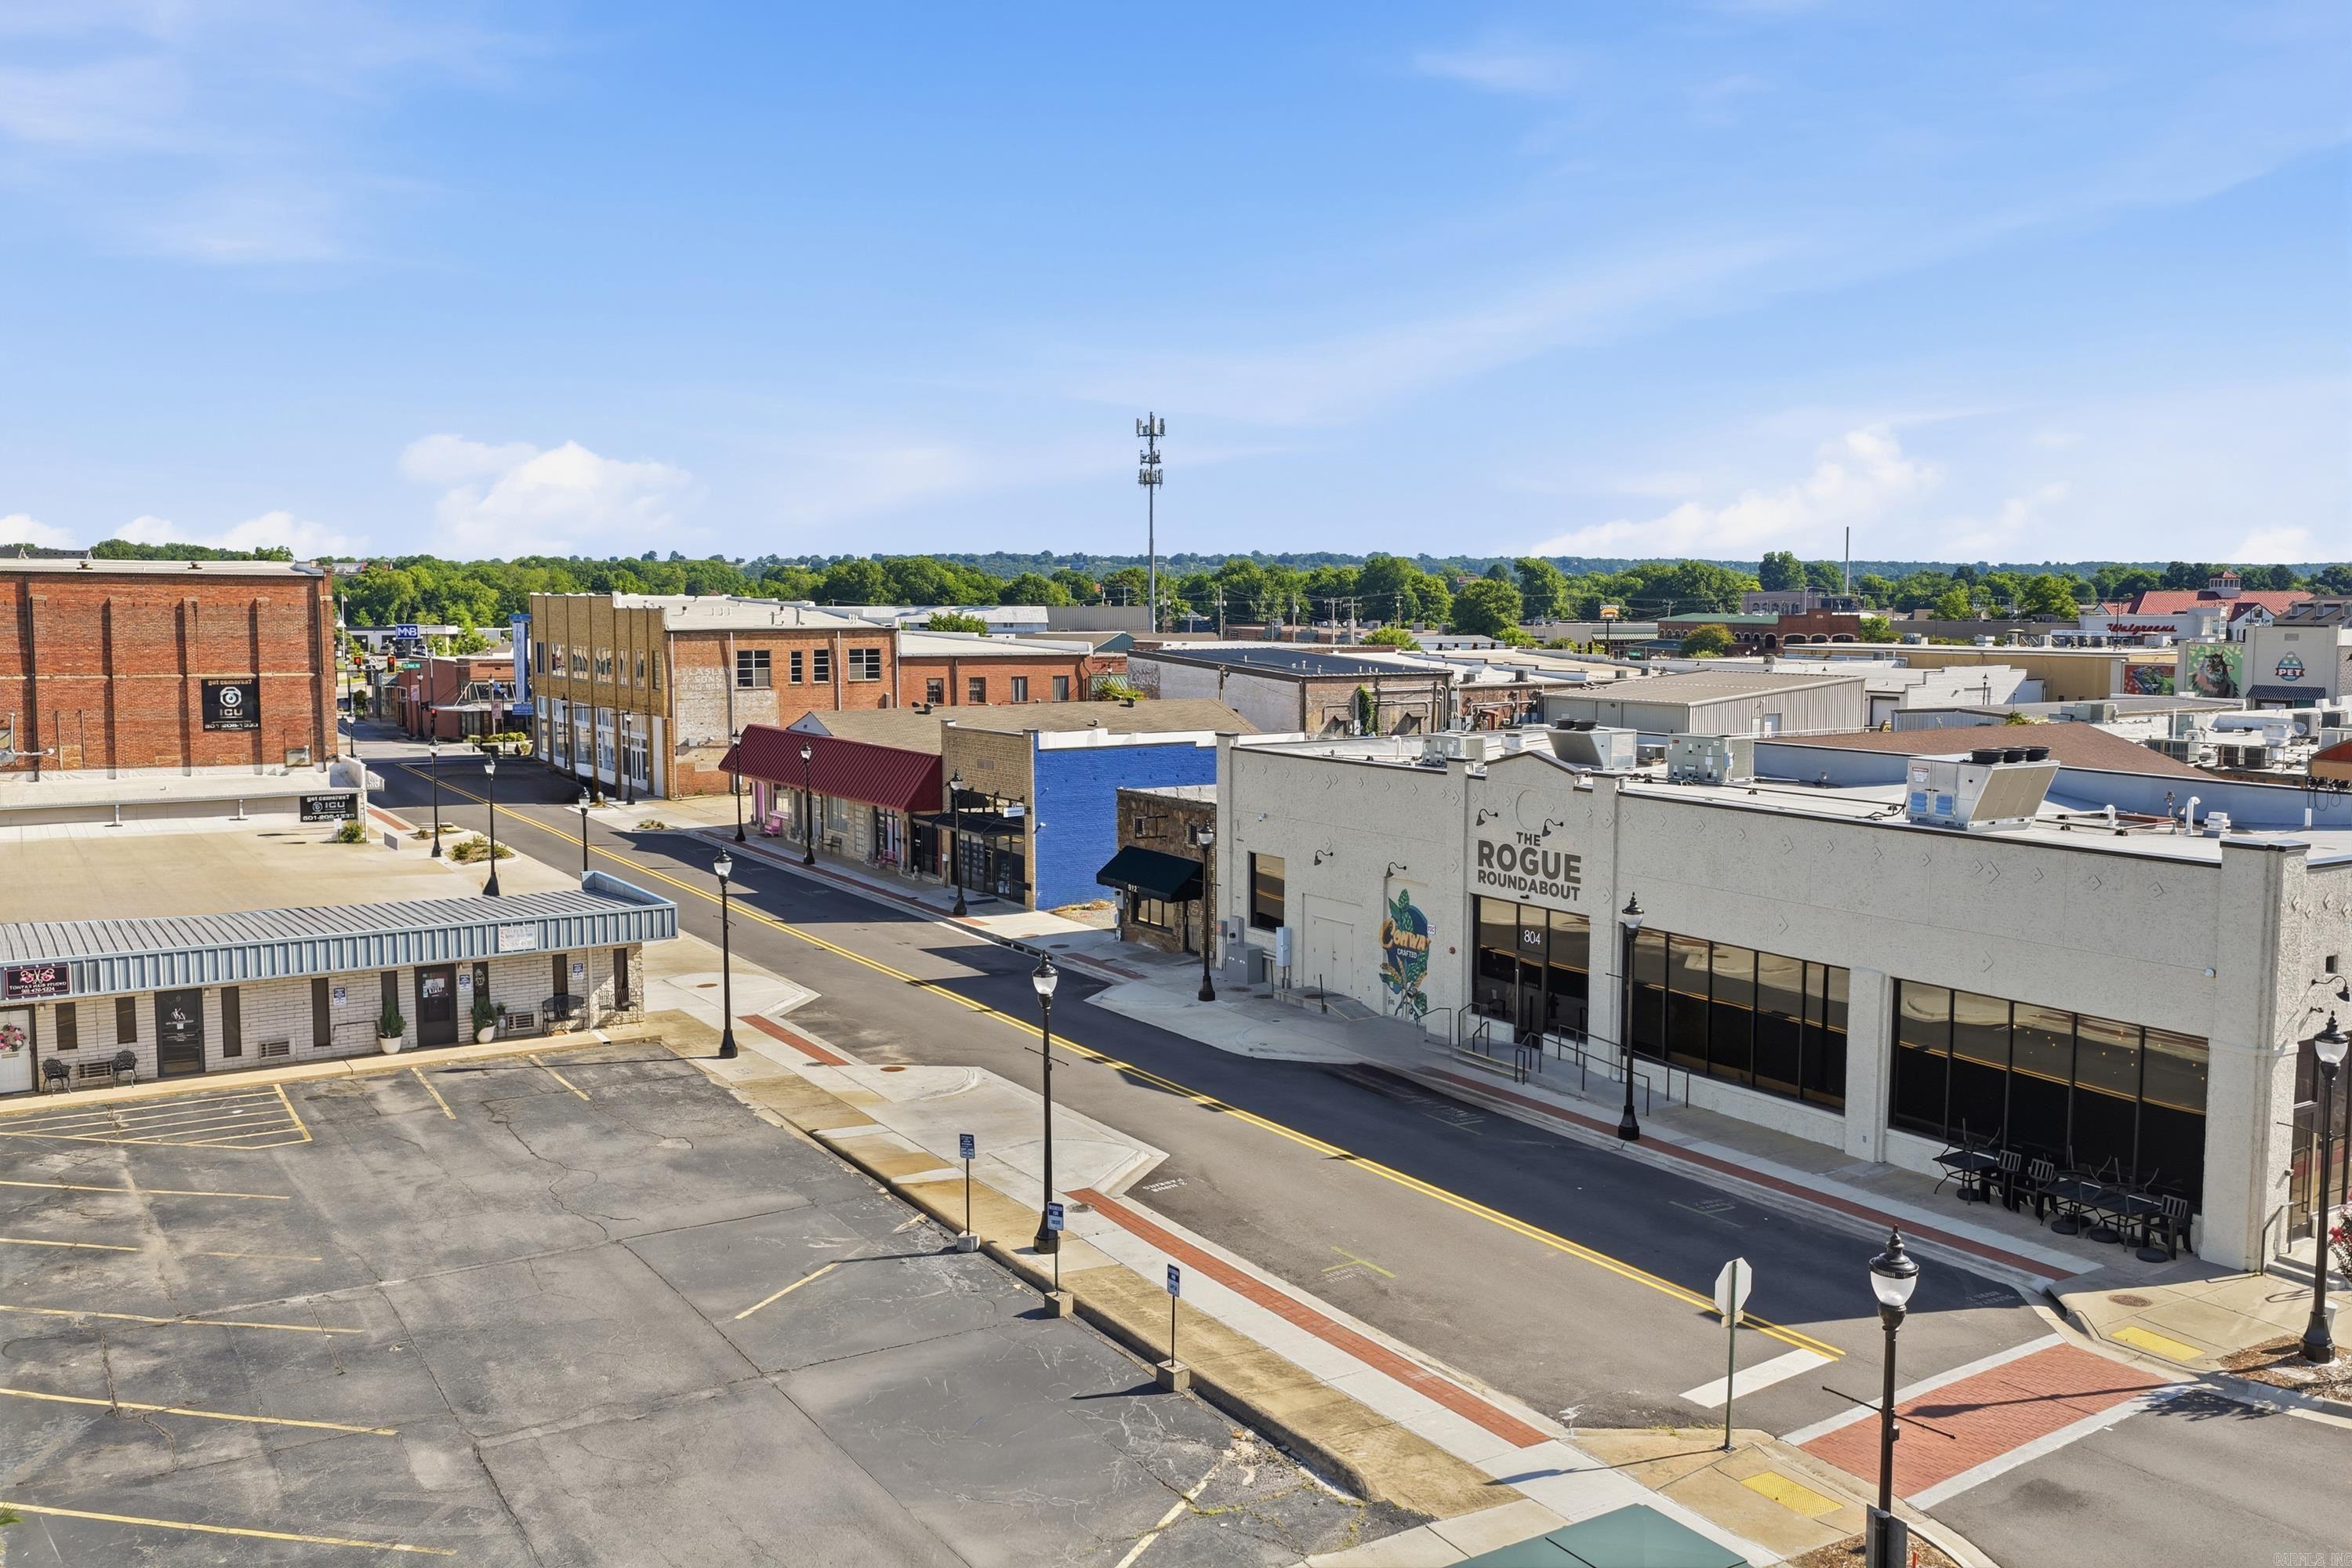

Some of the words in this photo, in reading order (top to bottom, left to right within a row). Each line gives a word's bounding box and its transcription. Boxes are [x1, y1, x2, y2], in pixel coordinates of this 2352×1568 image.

[397, 627, 417, 637] MNB
[2107, 623, 2177, 635] Walgreens
[1516, 832, 1541, 847] THE
[1478, 840, 1581, 884] ROGUE
[1478, 869, 1581, 901] ROUNDABOUT
[1380, 917, 1431, 952] CONWAY
[1523, 929, 1541, 945] 804
[1396, 948, 1417, 959] CRAFTED
